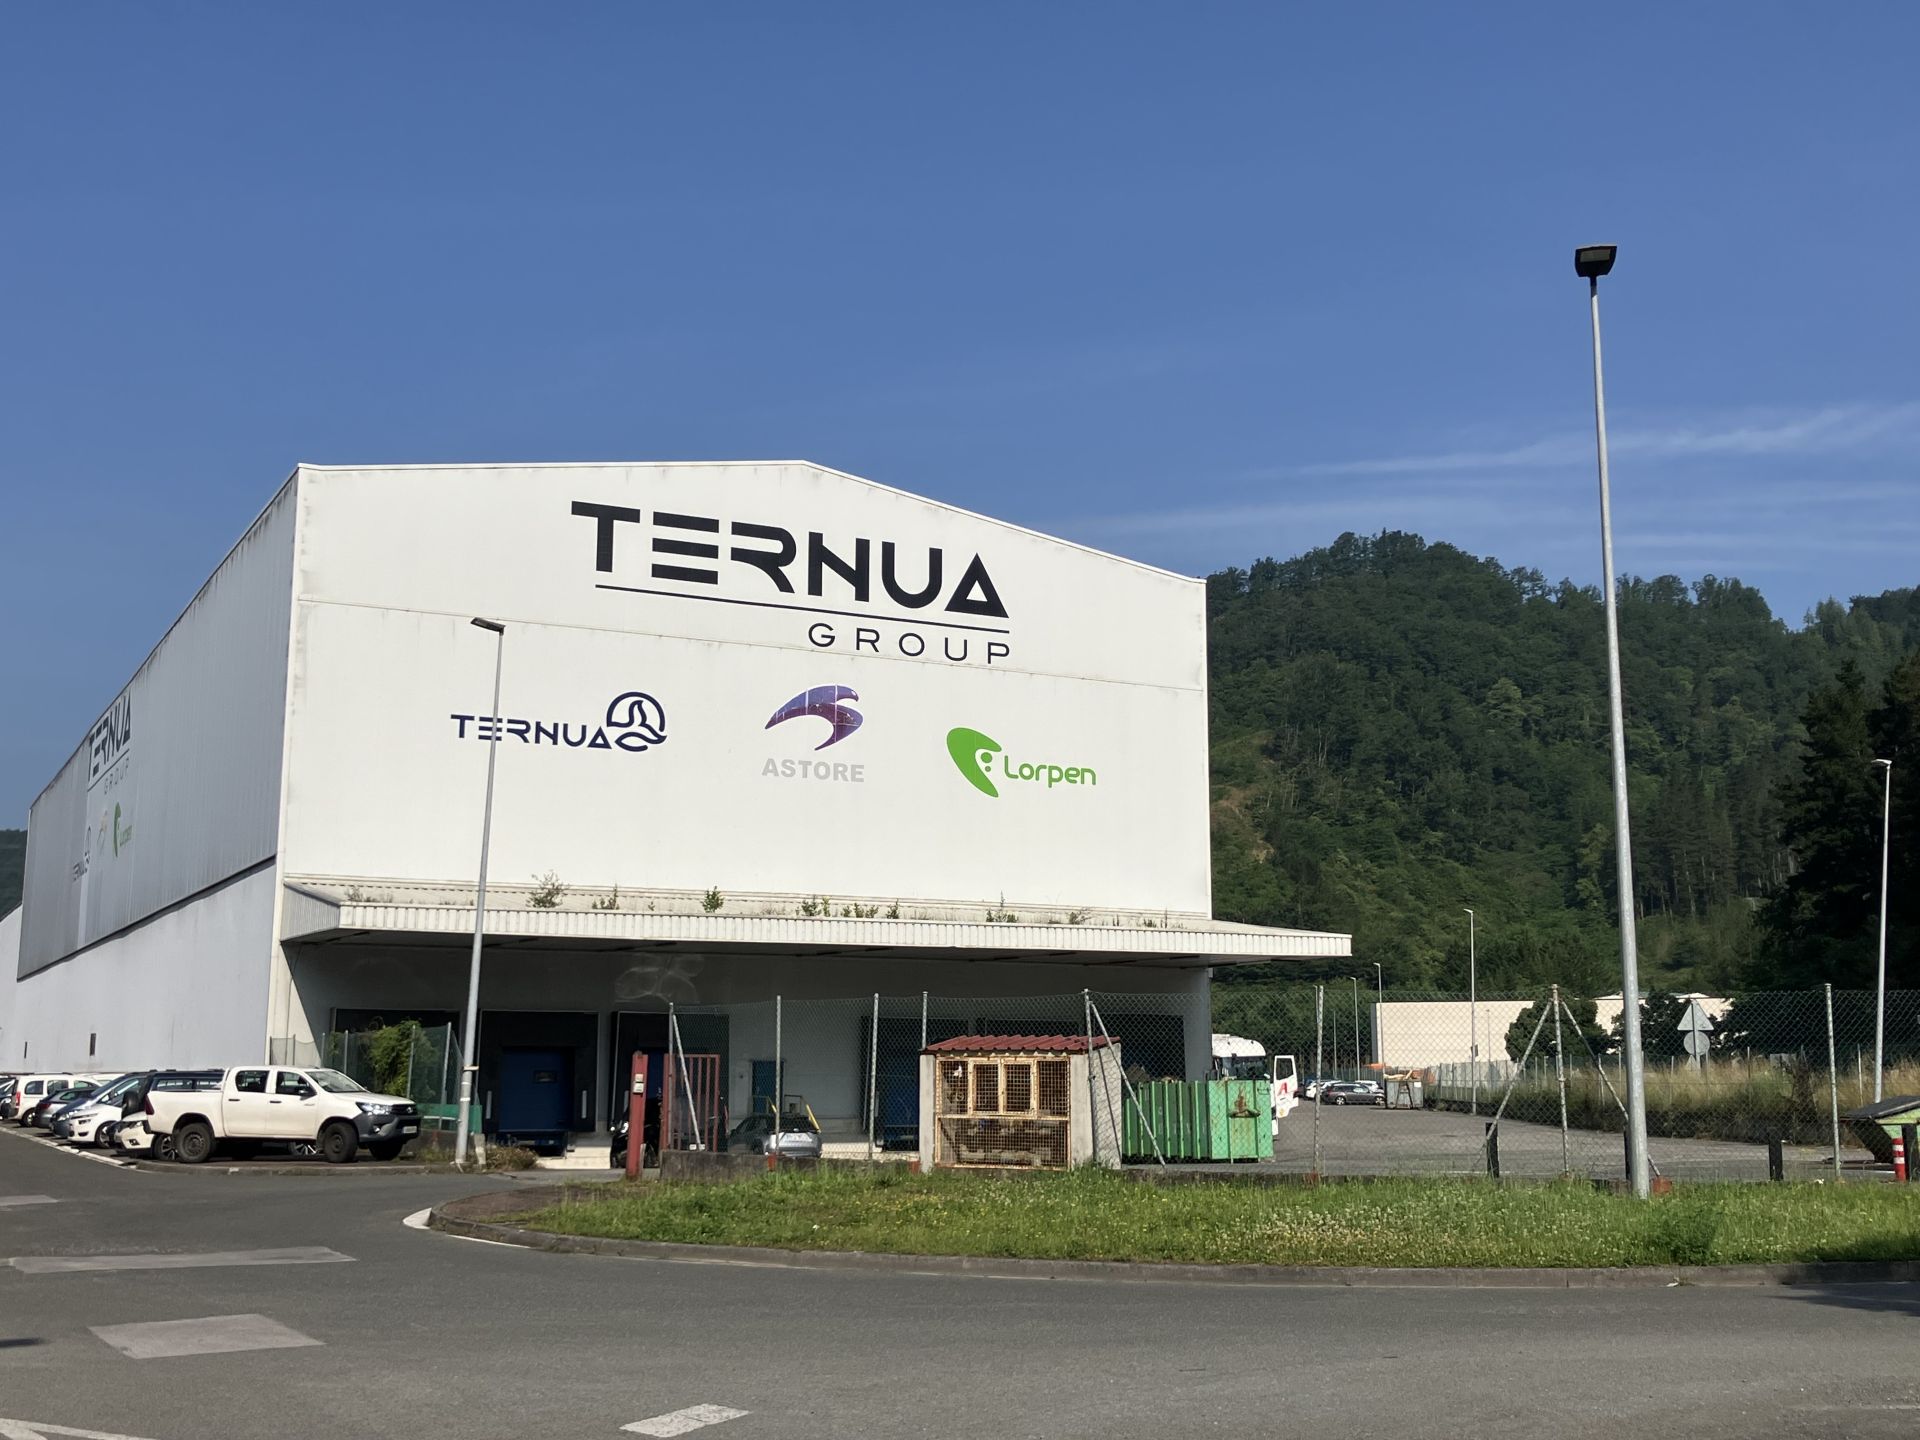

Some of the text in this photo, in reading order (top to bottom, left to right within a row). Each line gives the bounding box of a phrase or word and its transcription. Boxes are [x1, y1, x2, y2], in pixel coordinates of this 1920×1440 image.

[571, 501, 1011, 619] TERNUA
[808, 622, 1010, 665] GROUP
[89, 691, 131, 781] TERNUA
[450, 714, 612, 750] TERNUA
[761, 758, 866, 784] ASTORE
[1004, 754, 1097, 789] Lorpen
